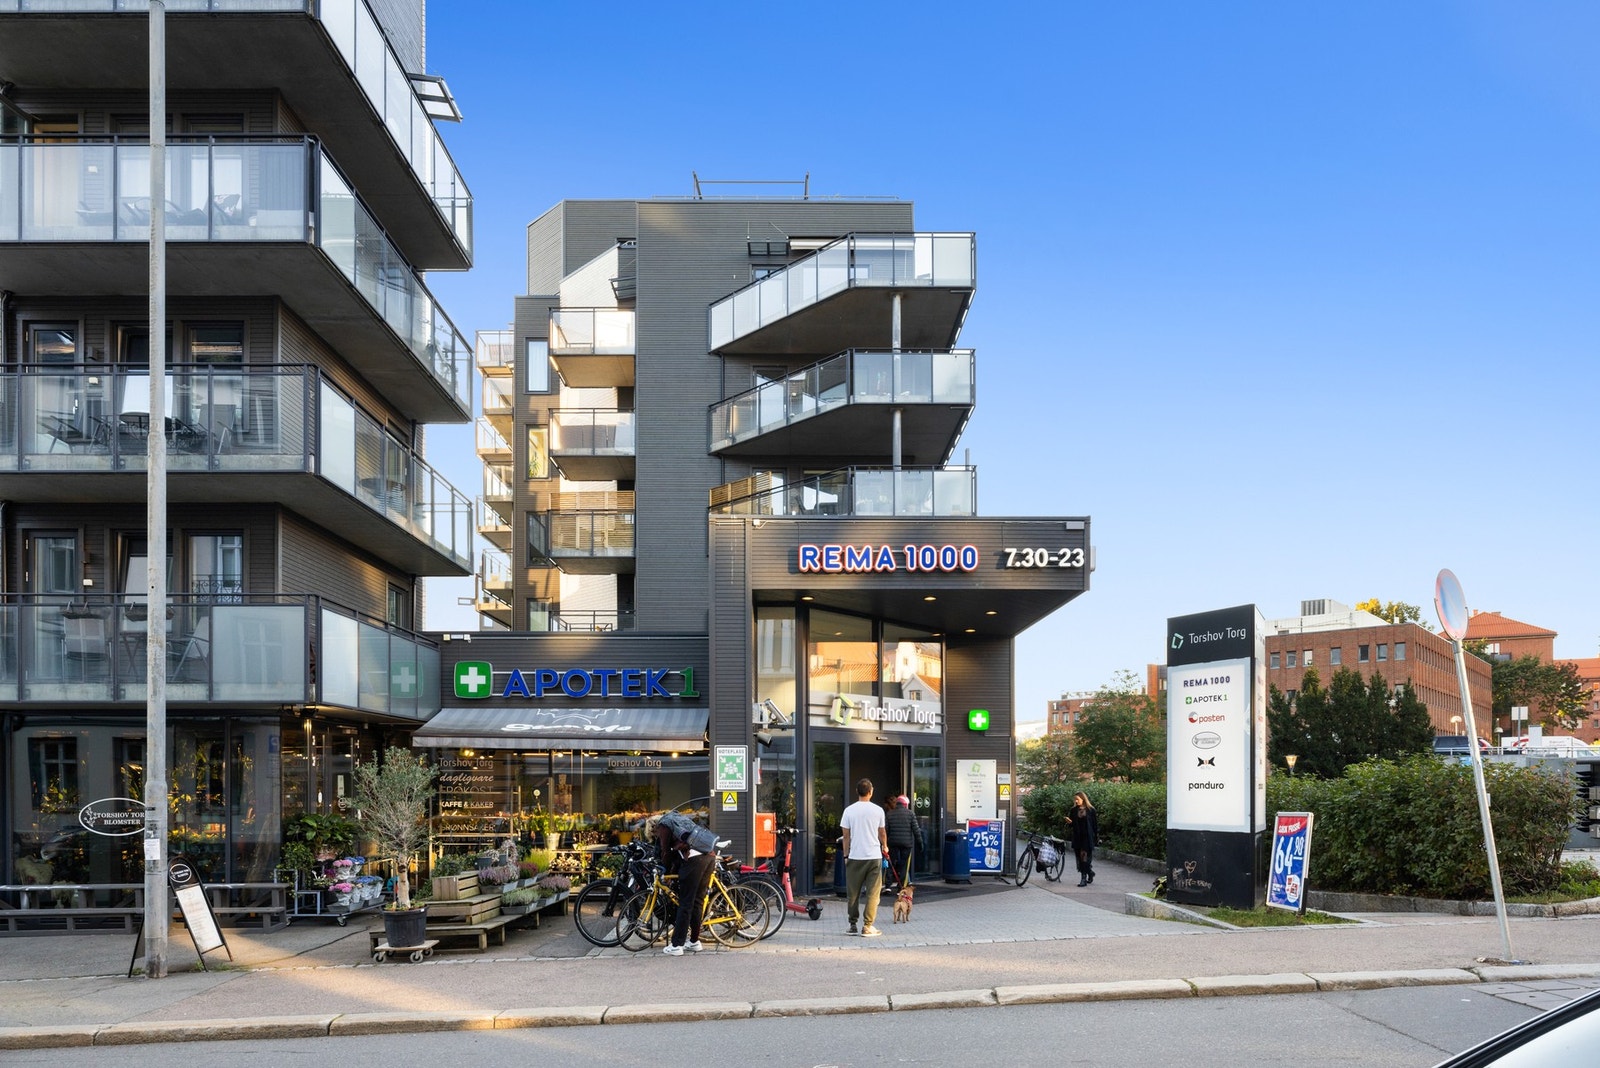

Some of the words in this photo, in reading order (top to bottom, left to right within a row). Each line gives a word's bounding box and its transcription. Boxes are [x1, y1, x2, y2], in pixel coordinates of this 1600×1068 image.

[799, 544, 897, 572] REMA
[903, 544, 979, 572] 1000
[1004, 547, 1085, 568] 7.30-23
[1188, 631, 1224, 644] Torshov
[1225, 627, 1246, 640] Torg
[502, 667, 671, 698] APOTEK
[679, 666, 699, 698] 1
[1183, 678, 1208, 688] REMA
[1210, 675, 1231, 685] 1000
[1193, 695, 1222, 703] APOTEK
[861, 700, 910, 723] Torshov
[911, 704, 936, 729] Torg
[1198, 714, 1225, 724] posten
[440, 758, 472, 767] Torshov
[475, 758, 494, 769] Torg
[607, 758, 641, 767] Torshov
[643, 758, 662, 769] Torg
[440, 772, 494, 785] dagligvare
[1188, 781, 1225, 791] panduro
[470, 801, 494, 809] KAKER
[969, 831, 999, 848] -25%
[1274, 836, 1294, 874] 64
